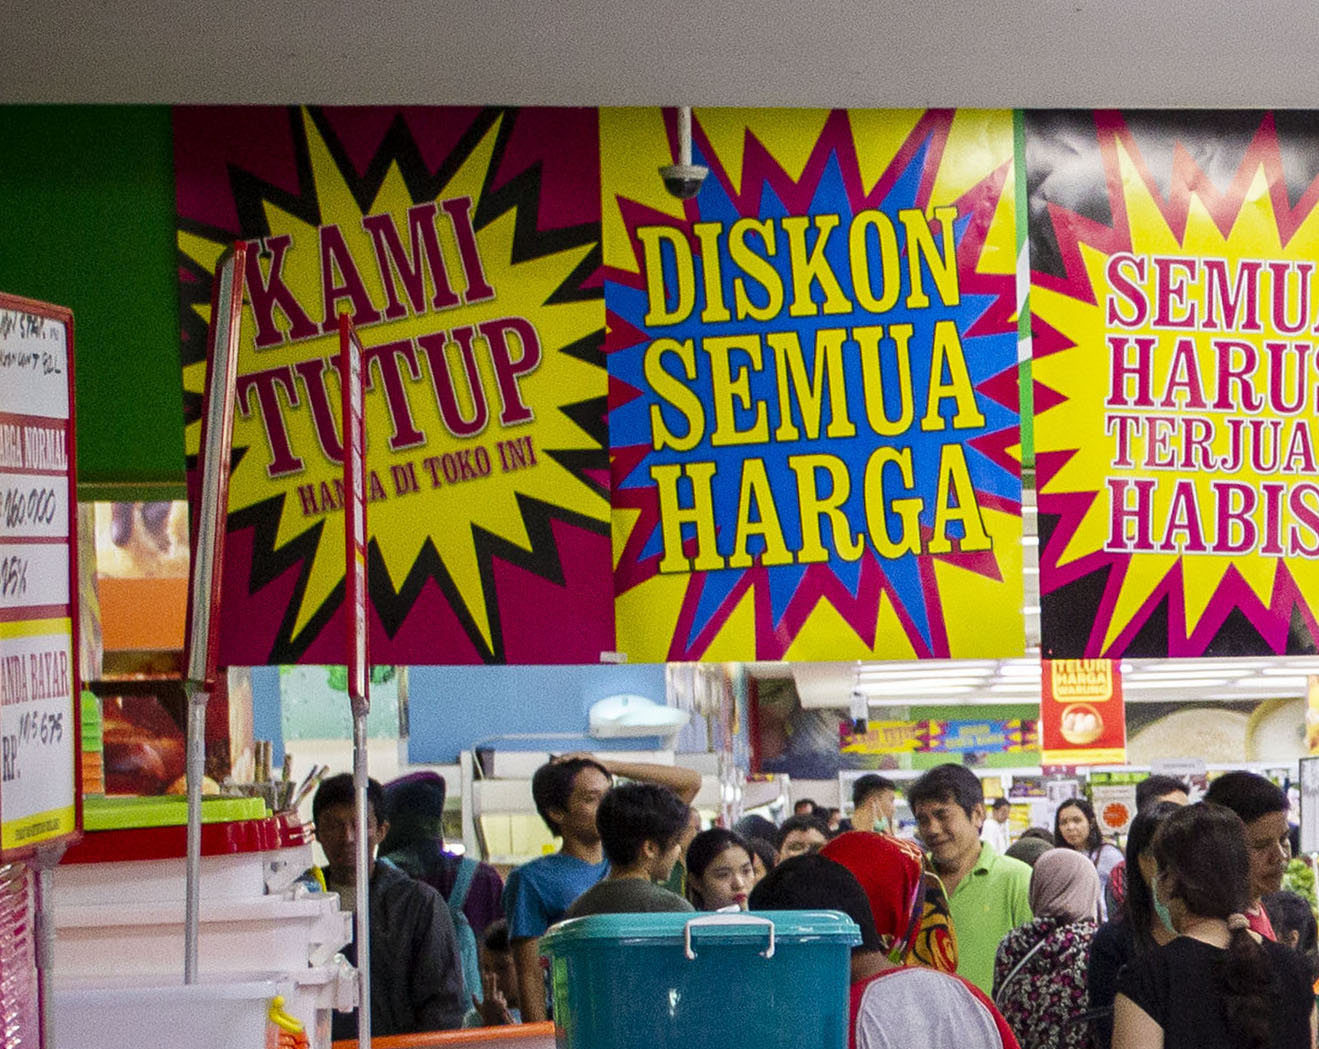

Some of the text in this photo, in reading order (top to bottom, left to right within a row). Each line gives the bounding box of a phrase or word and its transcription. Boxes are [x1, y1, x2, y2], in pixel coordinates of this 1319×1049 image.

[238, 195, 497, 350] KAMI
[634, 204, 963, 329] DISKON
[24, 427, 67, 471] NORMAL
[236, 315, 544, 478] TUTUP
[641, 319, 988, 453] SEMUA
[297, 436, 538, 517] HANA DI TOKO INI
[648, 439, 994, 575] HARGA
[1, 650, 70, 706] ANDA BAYAR
